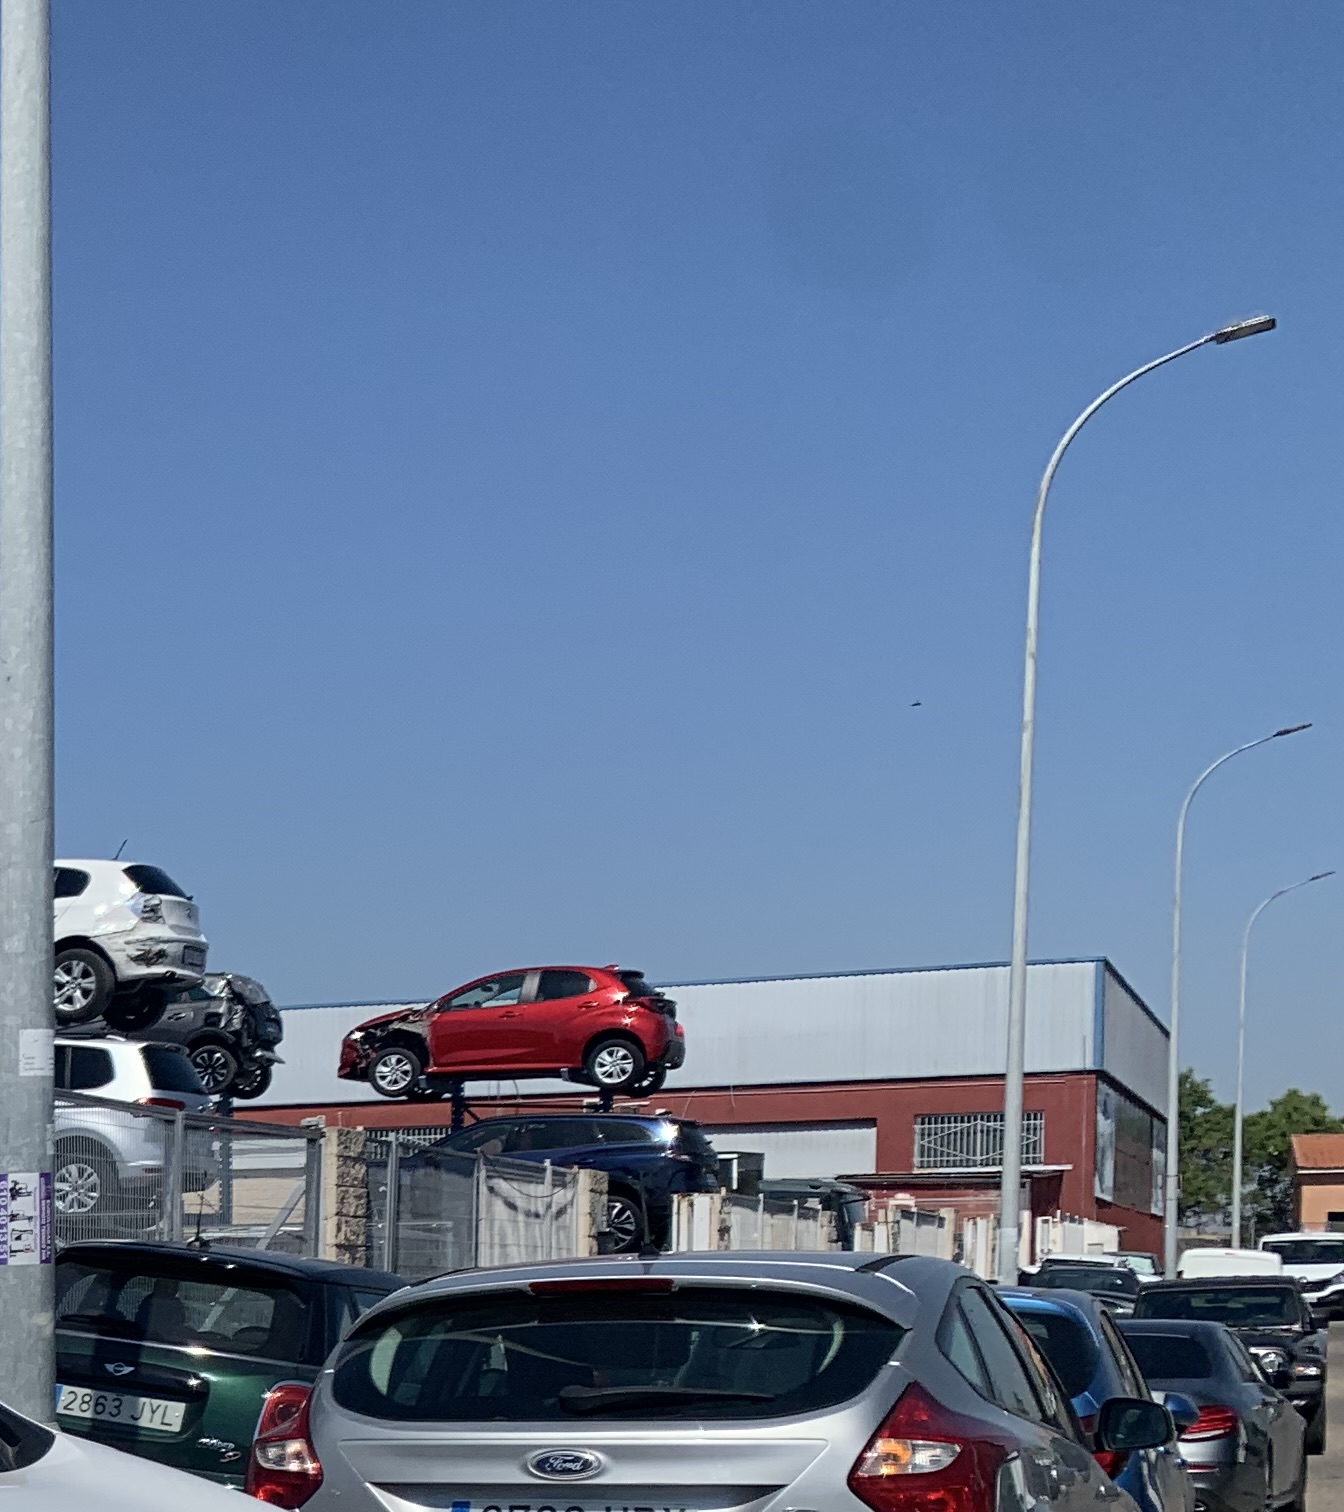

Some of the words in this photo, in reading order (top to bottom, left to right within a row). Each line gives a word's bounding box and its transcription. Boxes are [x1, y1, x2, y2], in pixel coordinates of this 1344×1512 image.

[0, 1181, 8, 1205] 610
[0, 1207, 8, 1224] 40
[0, 1228, 8, 1241] 13
[0, 1244, 8, 1259] 51
[63, 1391, 122, 1418] 2863
[131, 1400, 173, 1426] JYL
[546, 1455, 584, 1472] Ford
